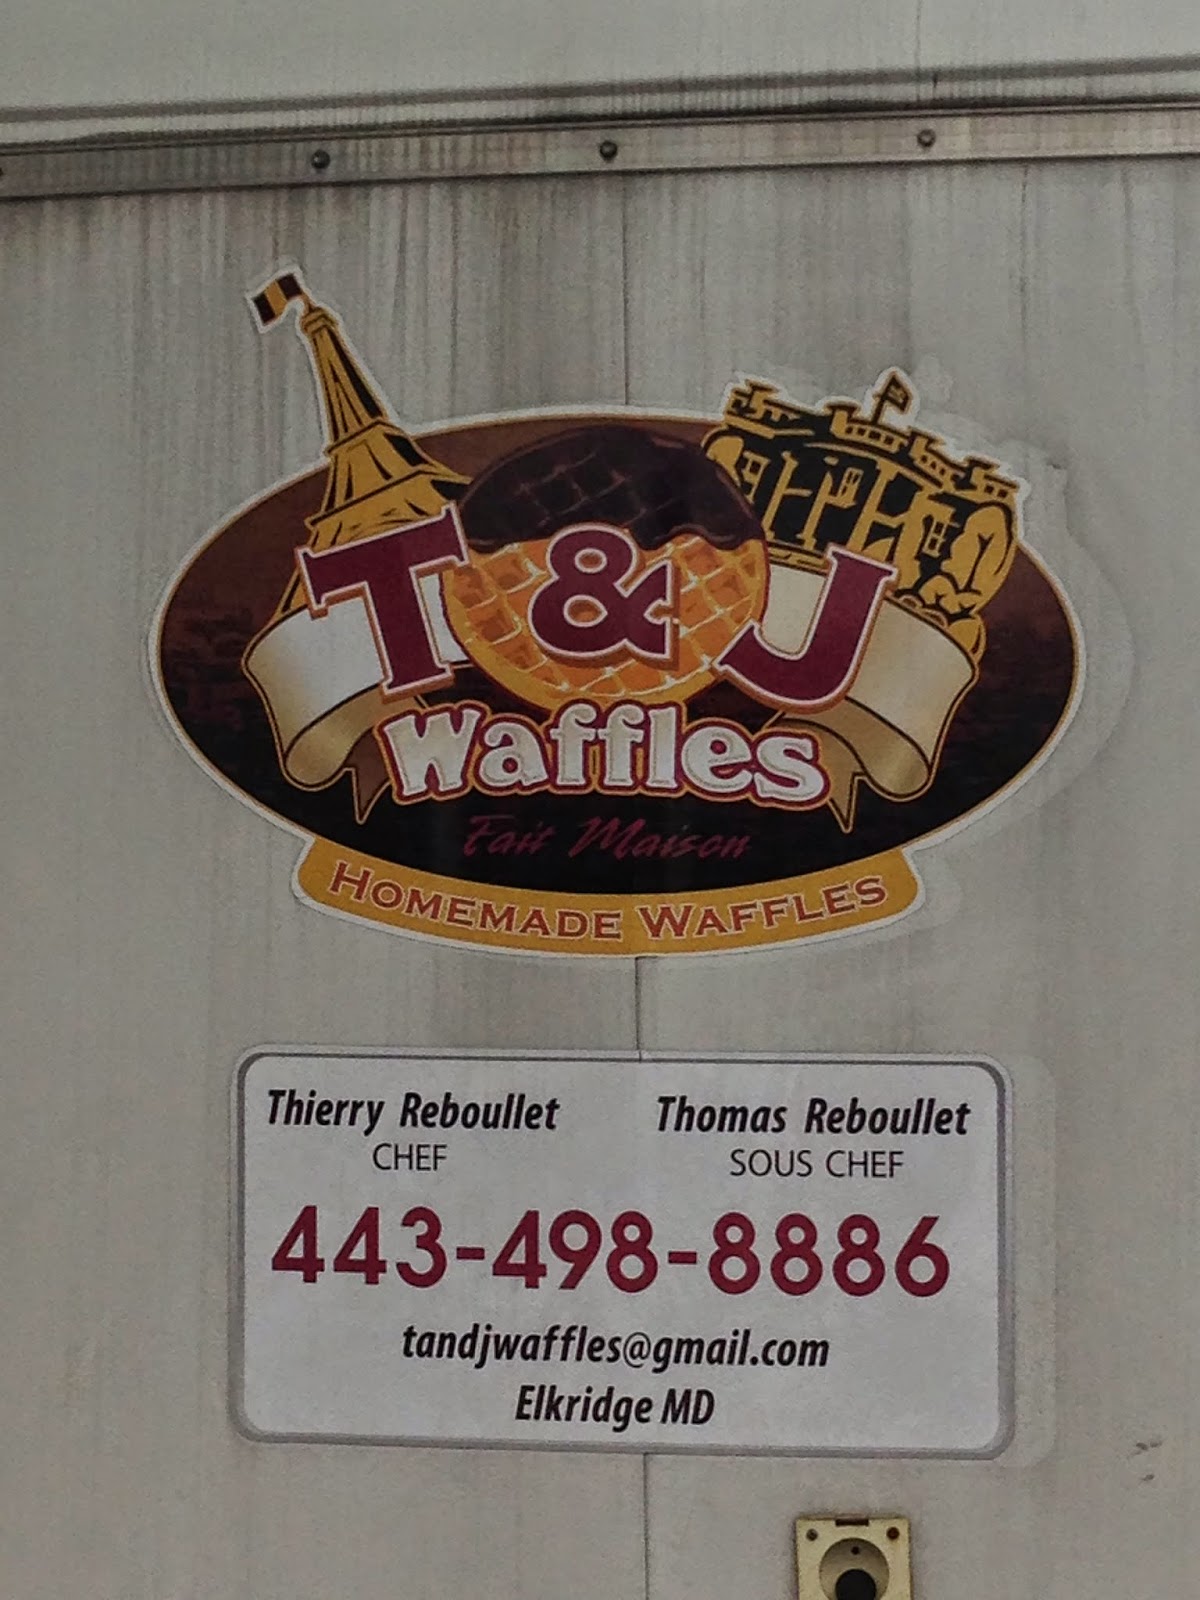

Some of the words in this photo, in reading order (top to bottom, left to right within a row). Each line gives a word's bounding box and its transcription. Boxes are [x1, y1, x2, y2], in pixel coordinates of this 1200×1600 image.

[380, 702, 829, 807] Waffles
[567, 816, 753, 860] Maison
[328, 860, 624, 941] HOMEMADE
[636, 873, 886, 942] WAFFLES
[267, 1088, 384, 1134] Thierry
[400, 1092, 561, 1131] Reboullet
[657, 1095, 787, 1135] Thomas
[805, 1096, 971, 1136] Reboullet
[372, 1142, 448, 1172] CHEF
[730, 1149, 813, 1178] SOUS
[826, 1149, 904, 1178] CHEF
[271, 1205, 951, 1298] 443-498-8886
[402, 1323, 830, 1372] tandjwaffles@gmail.com
[515, 1385, 652, 1432] Elkridge
[662, 1388, 715, 1425] MD
